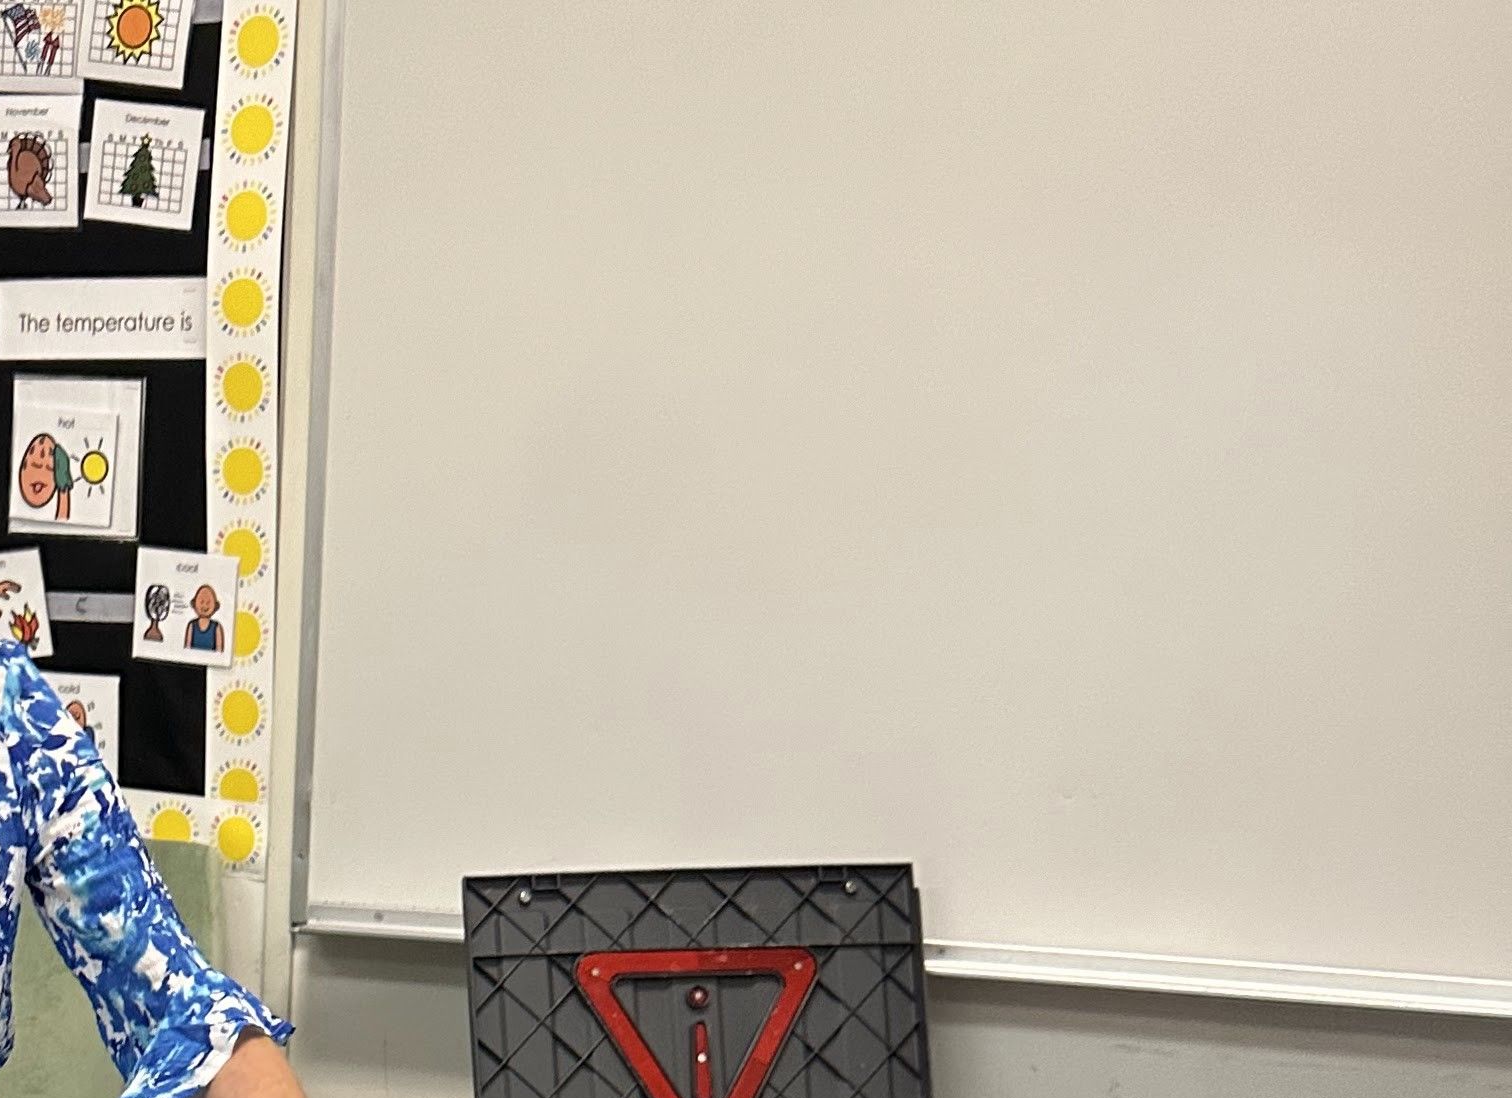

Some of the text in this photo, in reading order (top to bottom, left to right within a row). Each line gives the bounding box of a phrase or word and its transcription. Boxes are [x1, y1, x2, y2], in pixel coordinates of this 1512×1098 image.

[19, 311, 193, 336] The temperature is
[58, 416, 75, 429] hot
